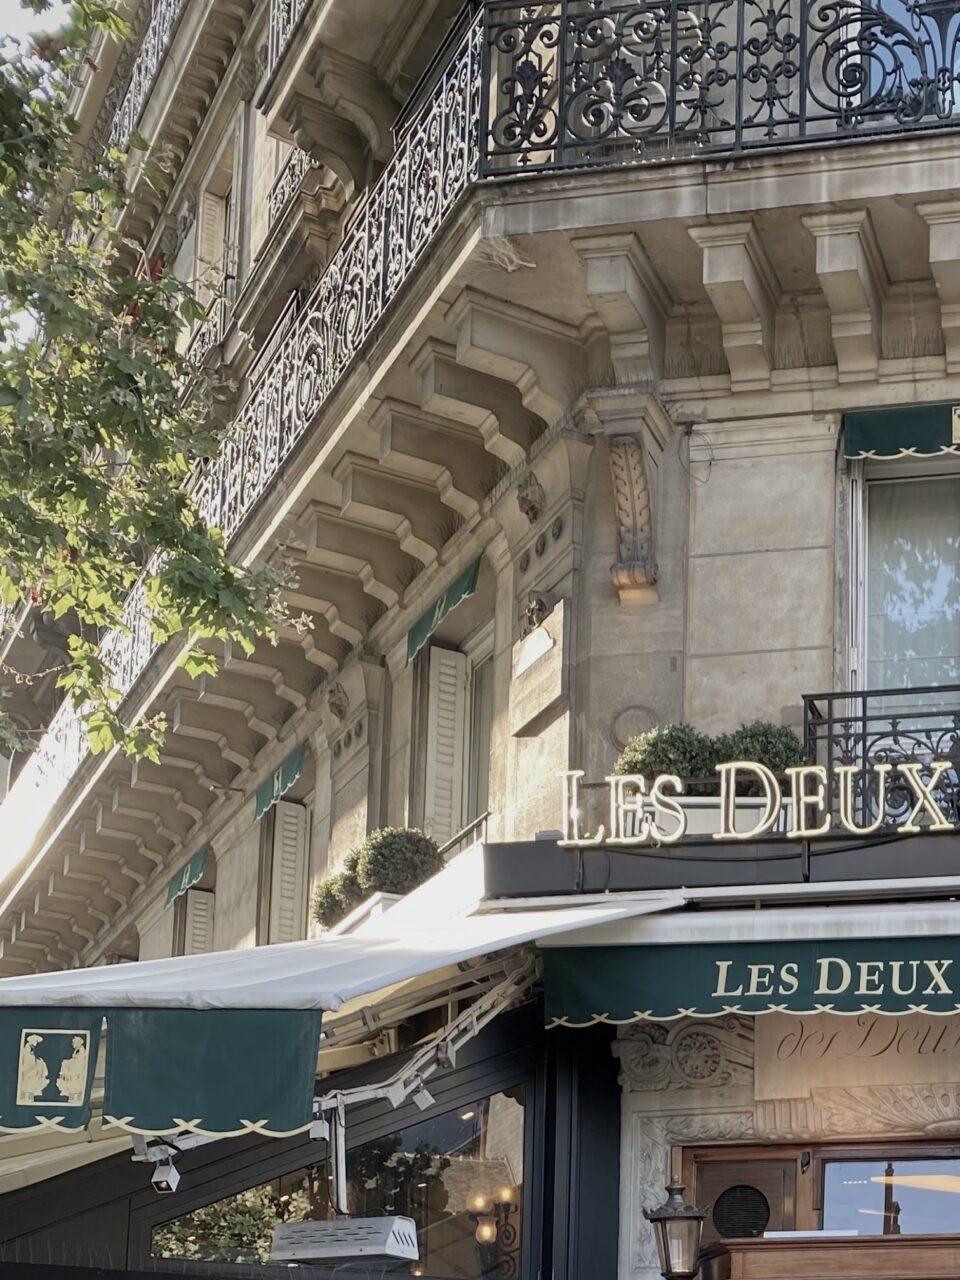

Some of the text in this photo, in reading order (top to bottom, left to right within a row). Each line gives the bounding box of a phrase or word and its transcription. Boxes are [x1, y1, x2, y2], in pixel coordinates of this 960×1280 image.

[557, 770, 687, 846] LES
[712, 761, 955, 839] DEUX
[711, 960, 799, 997] LES
[813, 957, 953, 996] DEUX
